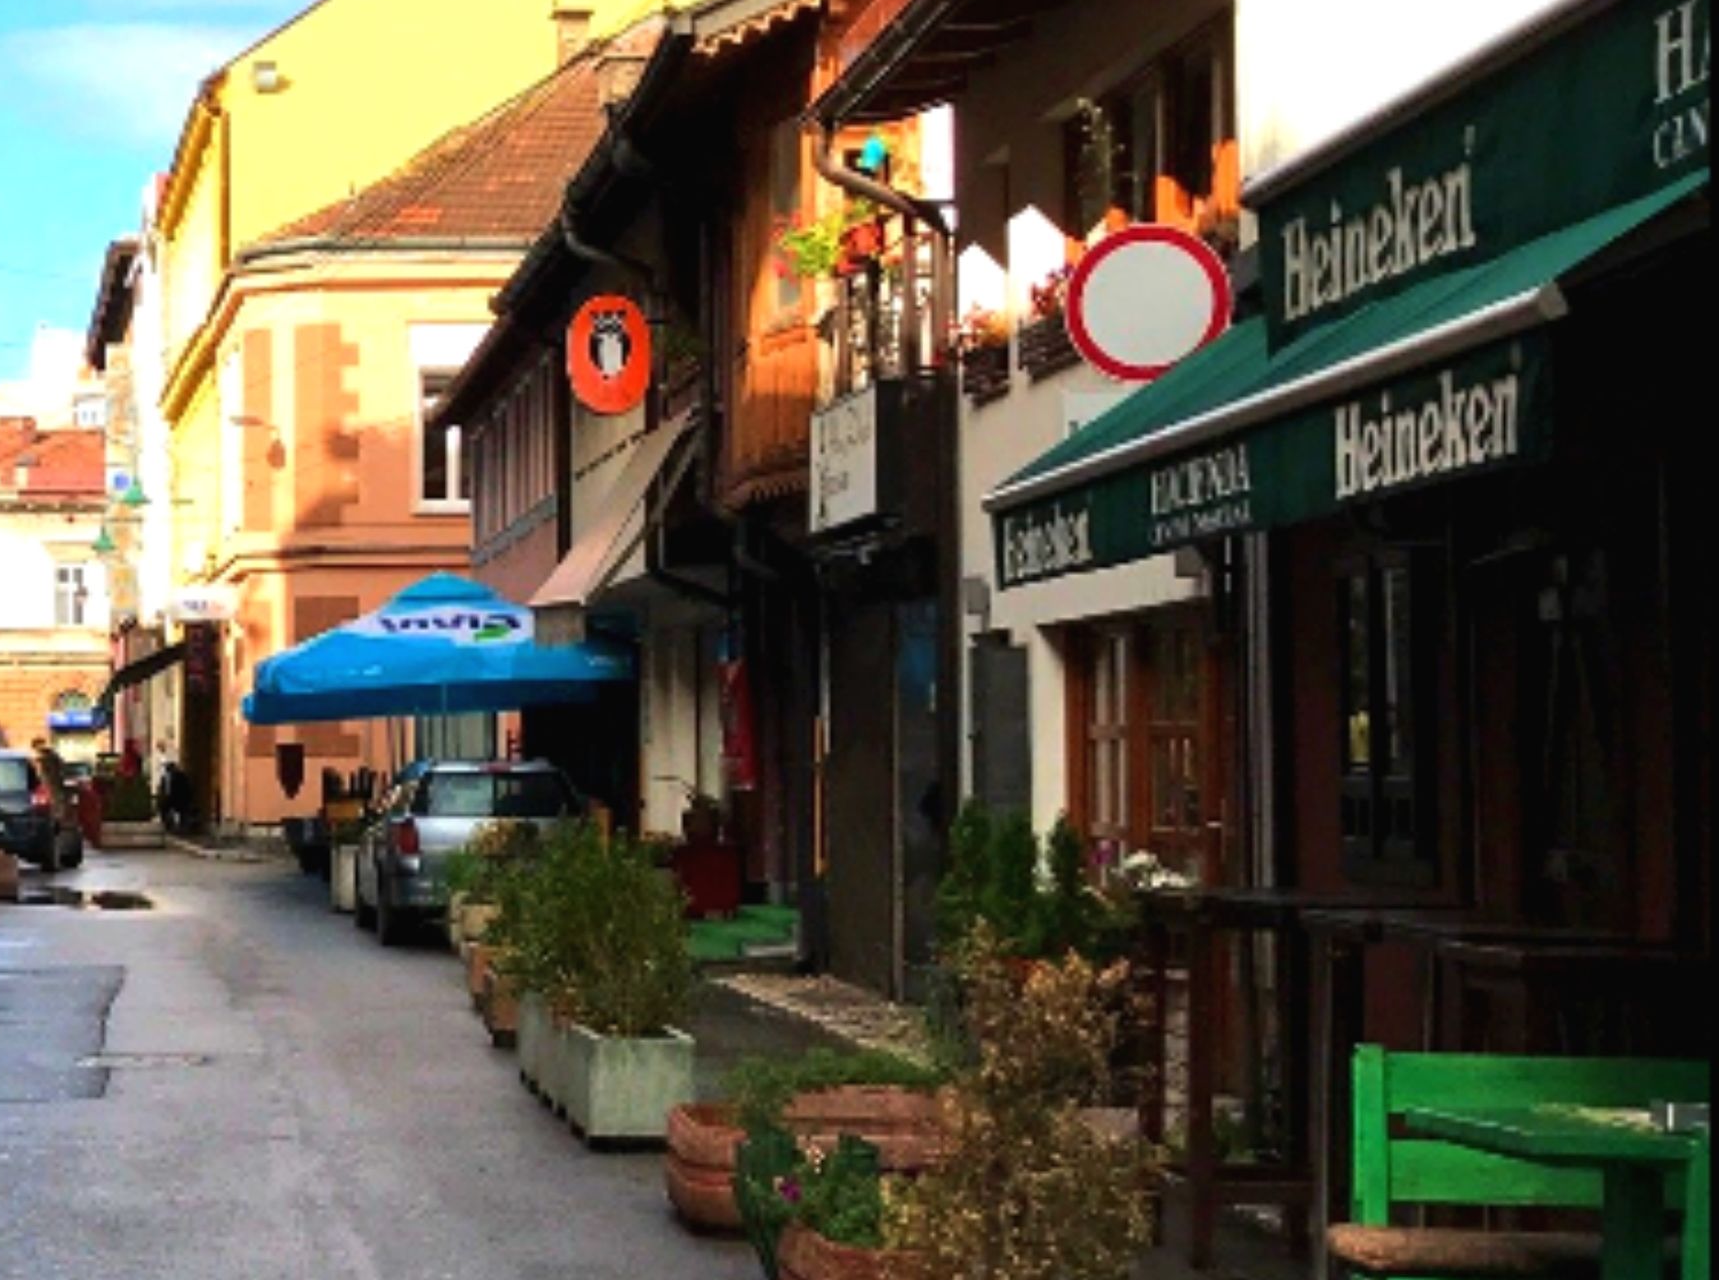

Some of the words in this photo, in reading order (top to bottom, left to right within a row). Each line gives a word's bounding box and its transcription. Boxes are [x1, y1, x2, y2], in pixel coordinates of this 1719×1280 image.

[1282, 165, 1478, 322] Heineken
[1334, 372, 1518, 501] Heineken
[1002, 499, 1094, 584] Heineken
